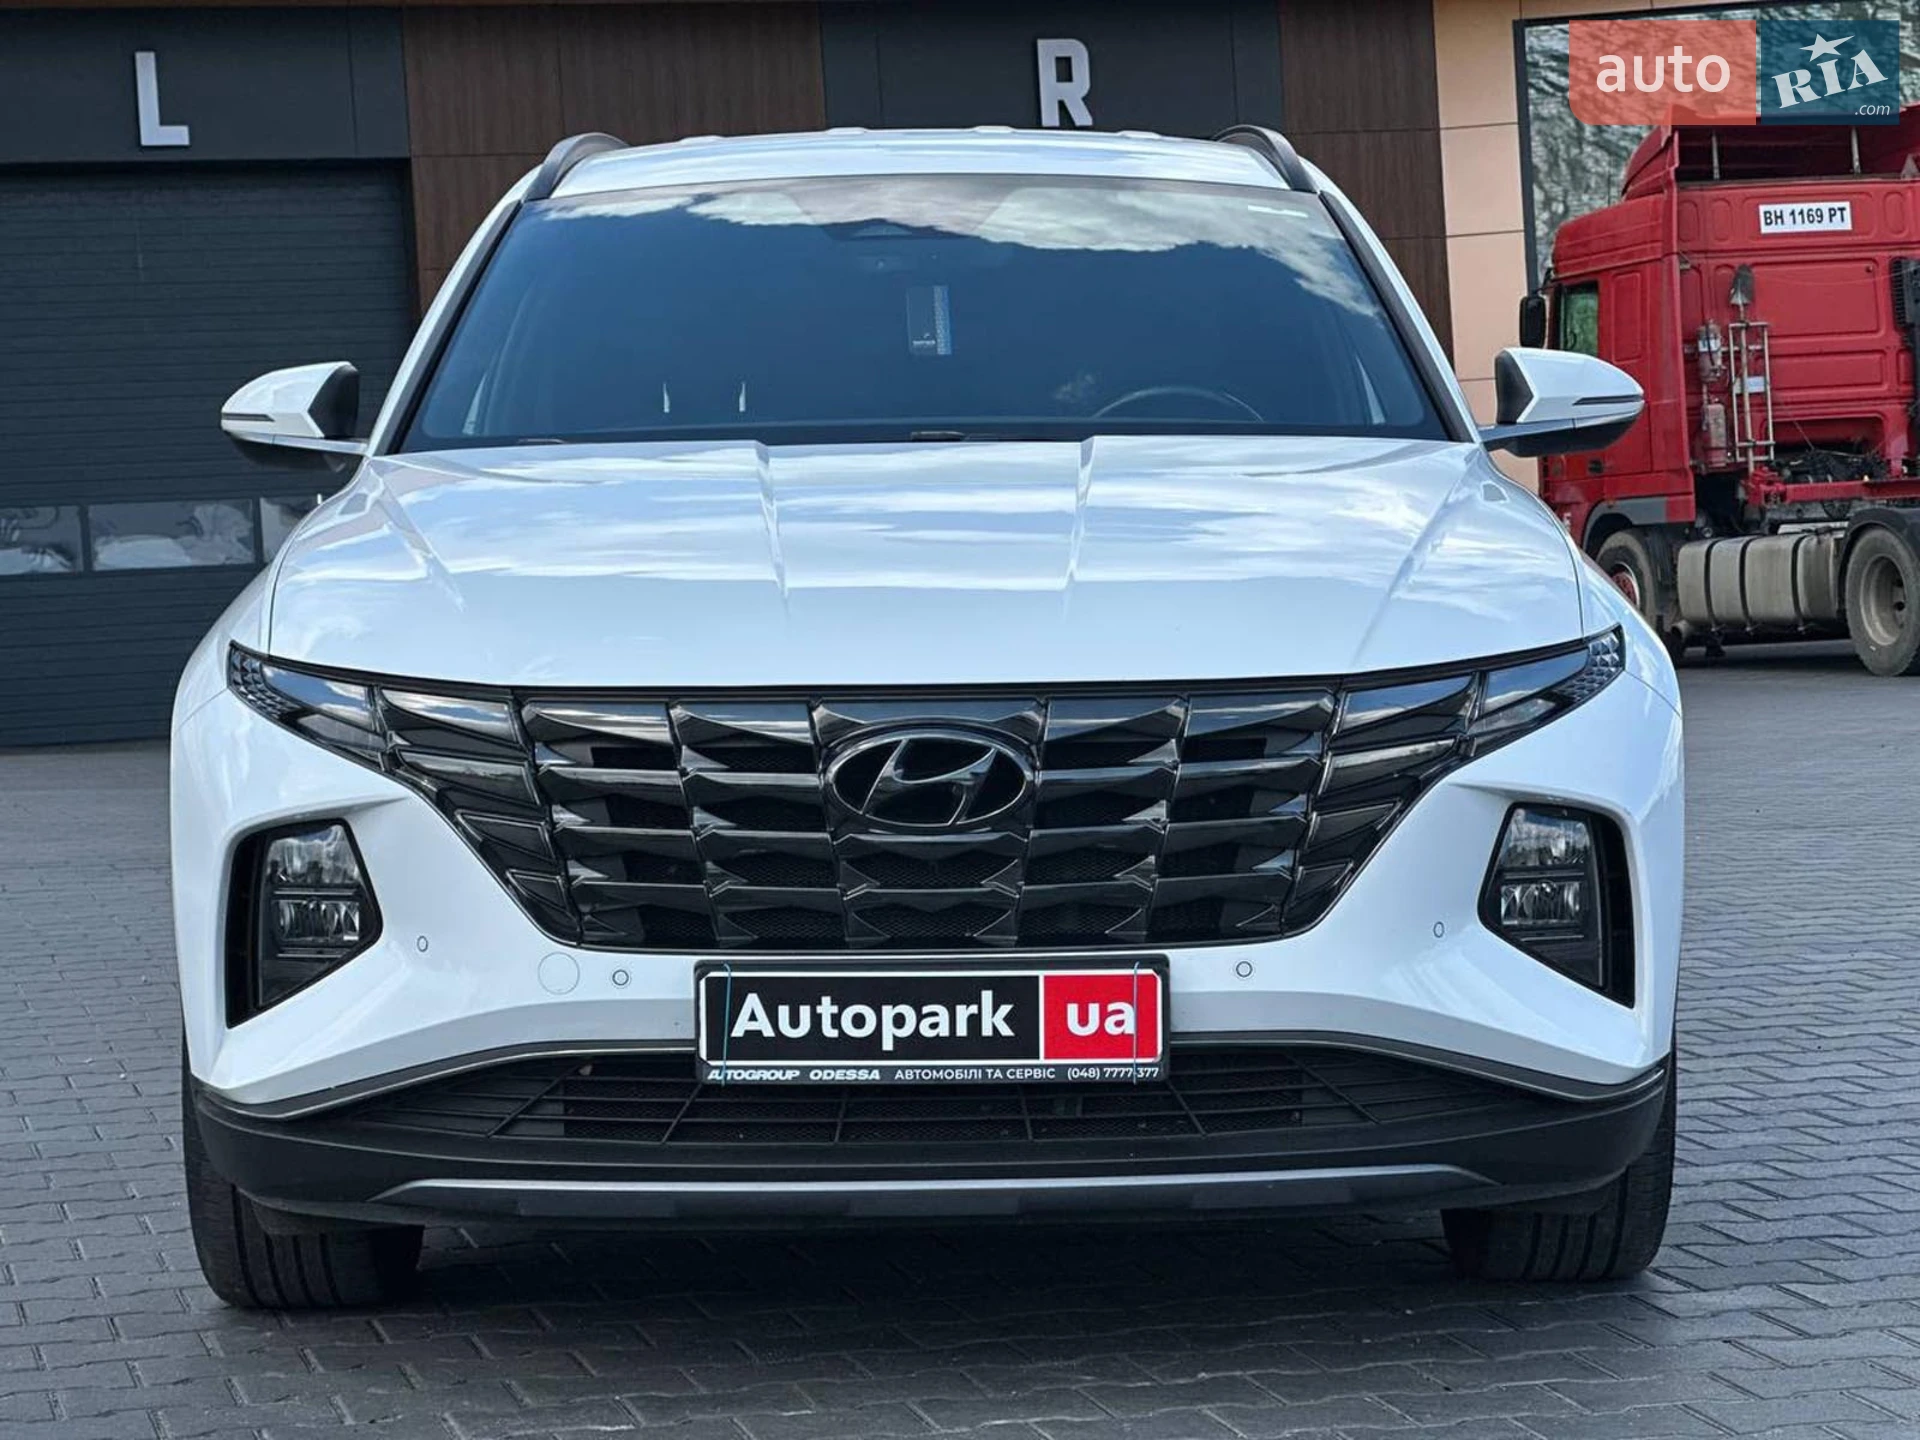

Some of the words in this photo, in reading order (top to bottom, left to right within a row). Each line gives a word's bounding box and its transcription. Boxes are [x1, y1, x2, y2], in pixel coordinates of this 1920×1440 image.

[134, 51, 190, 147] L
[1036, 38, 1094, 127] R
[1763, 210, 1784, 226] BH
[1789, 207, 1824, 224] 1169
[1828, 207, 1846, 223] PT
[730, 990, 1015, 1051] Autopark
[1067, 1001, 1135, 1037] ua
[707, 1069, 800, 1080] AUTOGROUP
[809, 1069, 881, 1080] ODESSA
[894, 1068, 983, 1080] АВТОМОБІЛІ
[986, 1068, 1003, 1079] ТА
[1006, 1067, 1056, 1079] СЕРВІС
[1067, 1067, 1100, 1080] (048)
